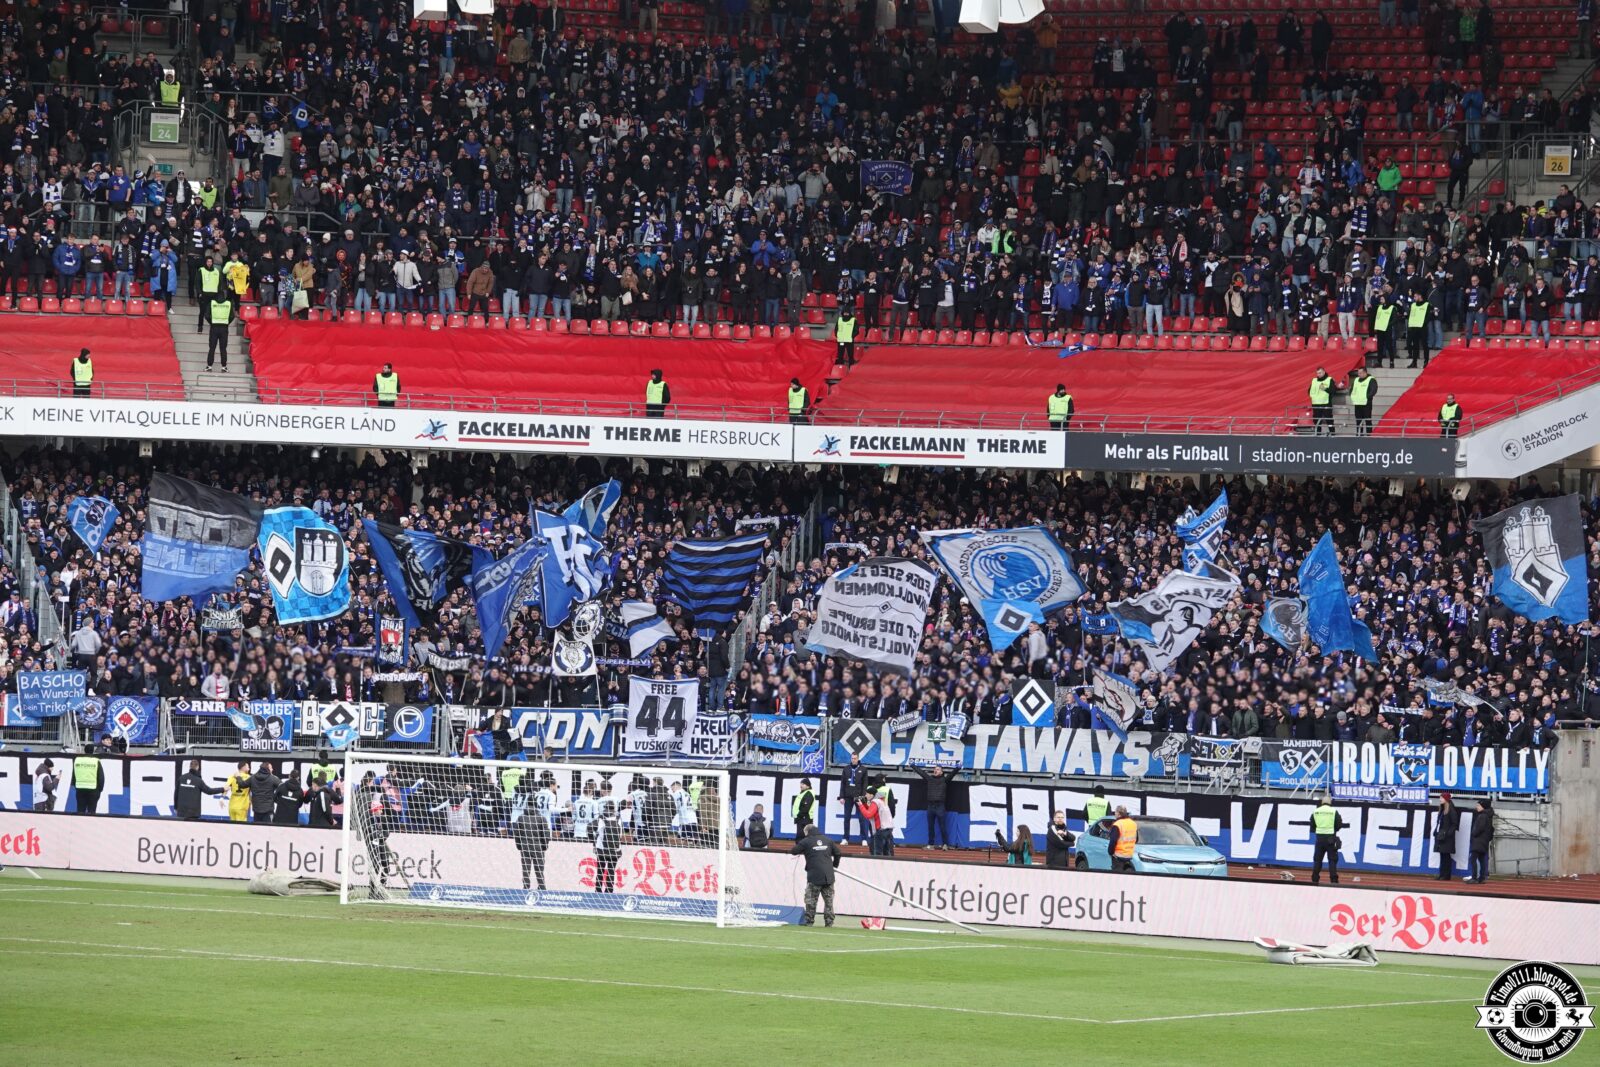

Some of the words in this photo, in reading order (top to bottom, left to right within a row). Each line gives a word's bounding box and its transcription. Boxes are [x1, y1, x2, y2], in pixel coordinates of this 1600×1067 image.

[158, 129, 171, 140] 24
[1551, 161, 1564, 172] 26
[33, 408, 84, 422] MEINE
[89, 409, 200, 427] VITALQUELLE
[206, 413, 224, 426] IM
[230, 411, 345, 430] NÜRNBERGER
[351, 417, 396, 432] LAND
[1521, 430, 1543, 444] MAX
[1543, 412, 1589, 435] MORLOCK
[458, 421, 591, 440] FACKELMANN
[603, 426, 681, 442] THERME
[688, 429, 781, 447] HERSBRUCK
[850, 435, 966, 452] FACKELMANN
[977, 438, 1047, 454] THERME
[1524, 430, 1564, 451] STADION
[1105, 444, 1143, 459] Mehr
[1146, 445, 1169, 460] als
[1173, 445, 1229, 461] Fußball
[1252, 448, 1413, 468] stadion-nuernberg.de
[961, 535, 1019, 579] NORDDEUTSCHE
[1000, 575, 1042, 602] HSV
[20, 674, 85, 690] BASCHO
[24, 692, 40, 700] Mein
[41, 688, 86, 699] Wunsch?
[651, 683, 678, 695] FREE
[37, 700, 72, 713] Trikot
[635, 695, 688, 738] 44
[242, 739, 290, 751] BANDITEN
[634, 738, 684, 752] VUŠKOVIĆ
[881, 720, 1150, 778] CASTAWAYS
[1283, 739, 1323, 749] HAMBURG
[1332, 740, 1395, 785] IRON
[1429, 744, 1551, 790] LOYALTY
[0, 828, 41, 857] eck
[137, 836, 219, 866] Bewirb
[229, 841, 278, 871] Dich
[289, 849, 324, 874] bei
[632, 848, 719, 897] Beck
[888, 878, 1030, 922] Aufsteiger
[1040, 890, 1147, 925] gesucht
[1329, 903, 1386, 939] Der
[1391, 894, 1489, 950] Beck
